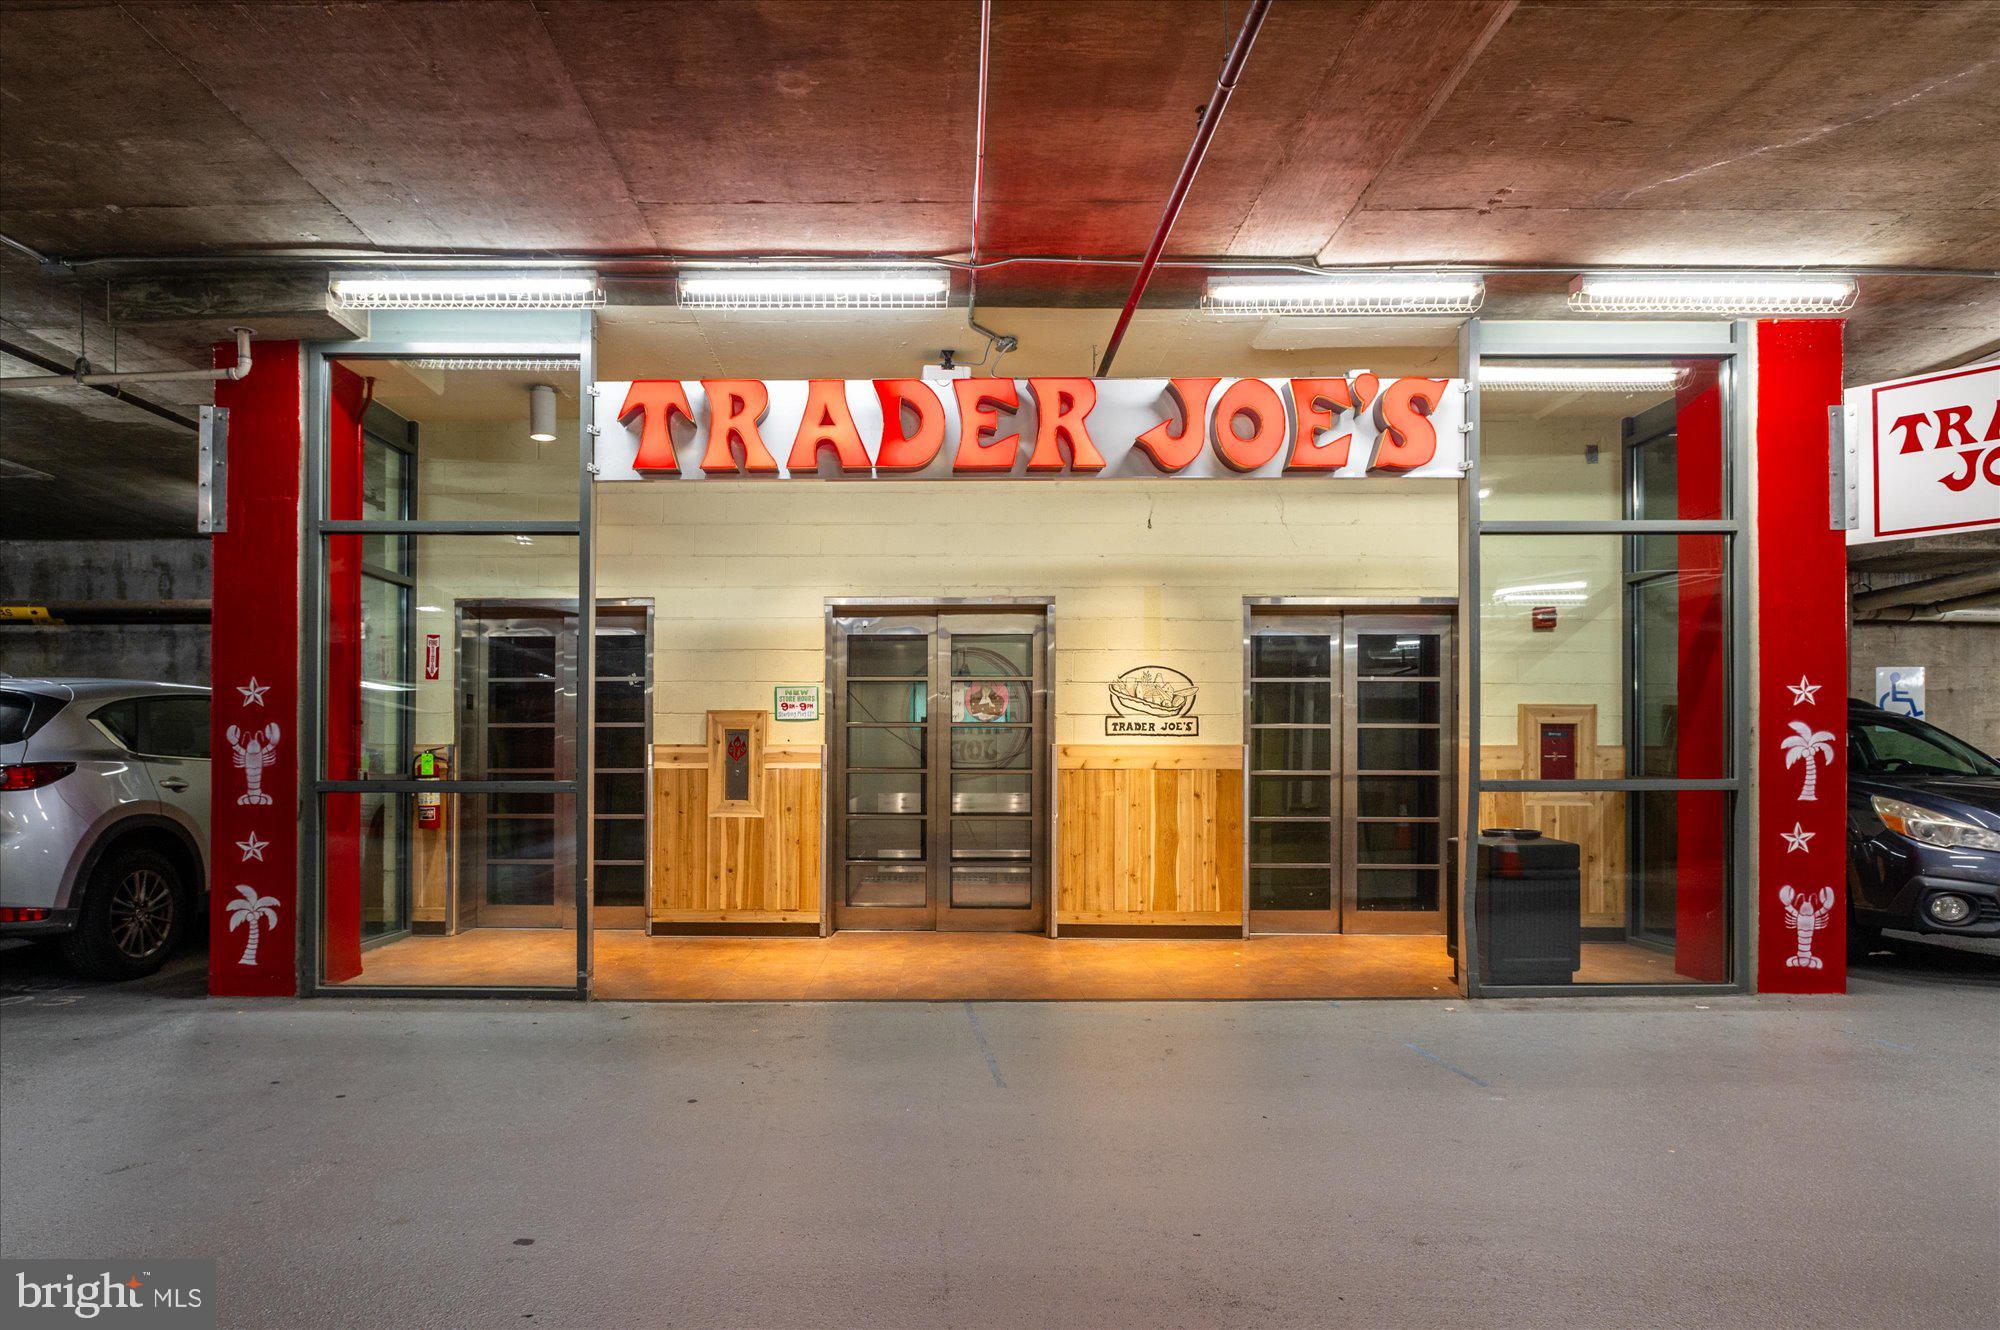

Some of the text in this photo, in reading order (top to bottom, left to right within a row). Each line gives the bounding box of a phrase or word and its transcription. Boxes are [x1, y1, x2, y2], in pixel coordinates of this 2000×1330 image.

[617, 373, 1448, 474] TRADER JOE'S
[1112, 722, 1194, 732] TRADER JOE'S
